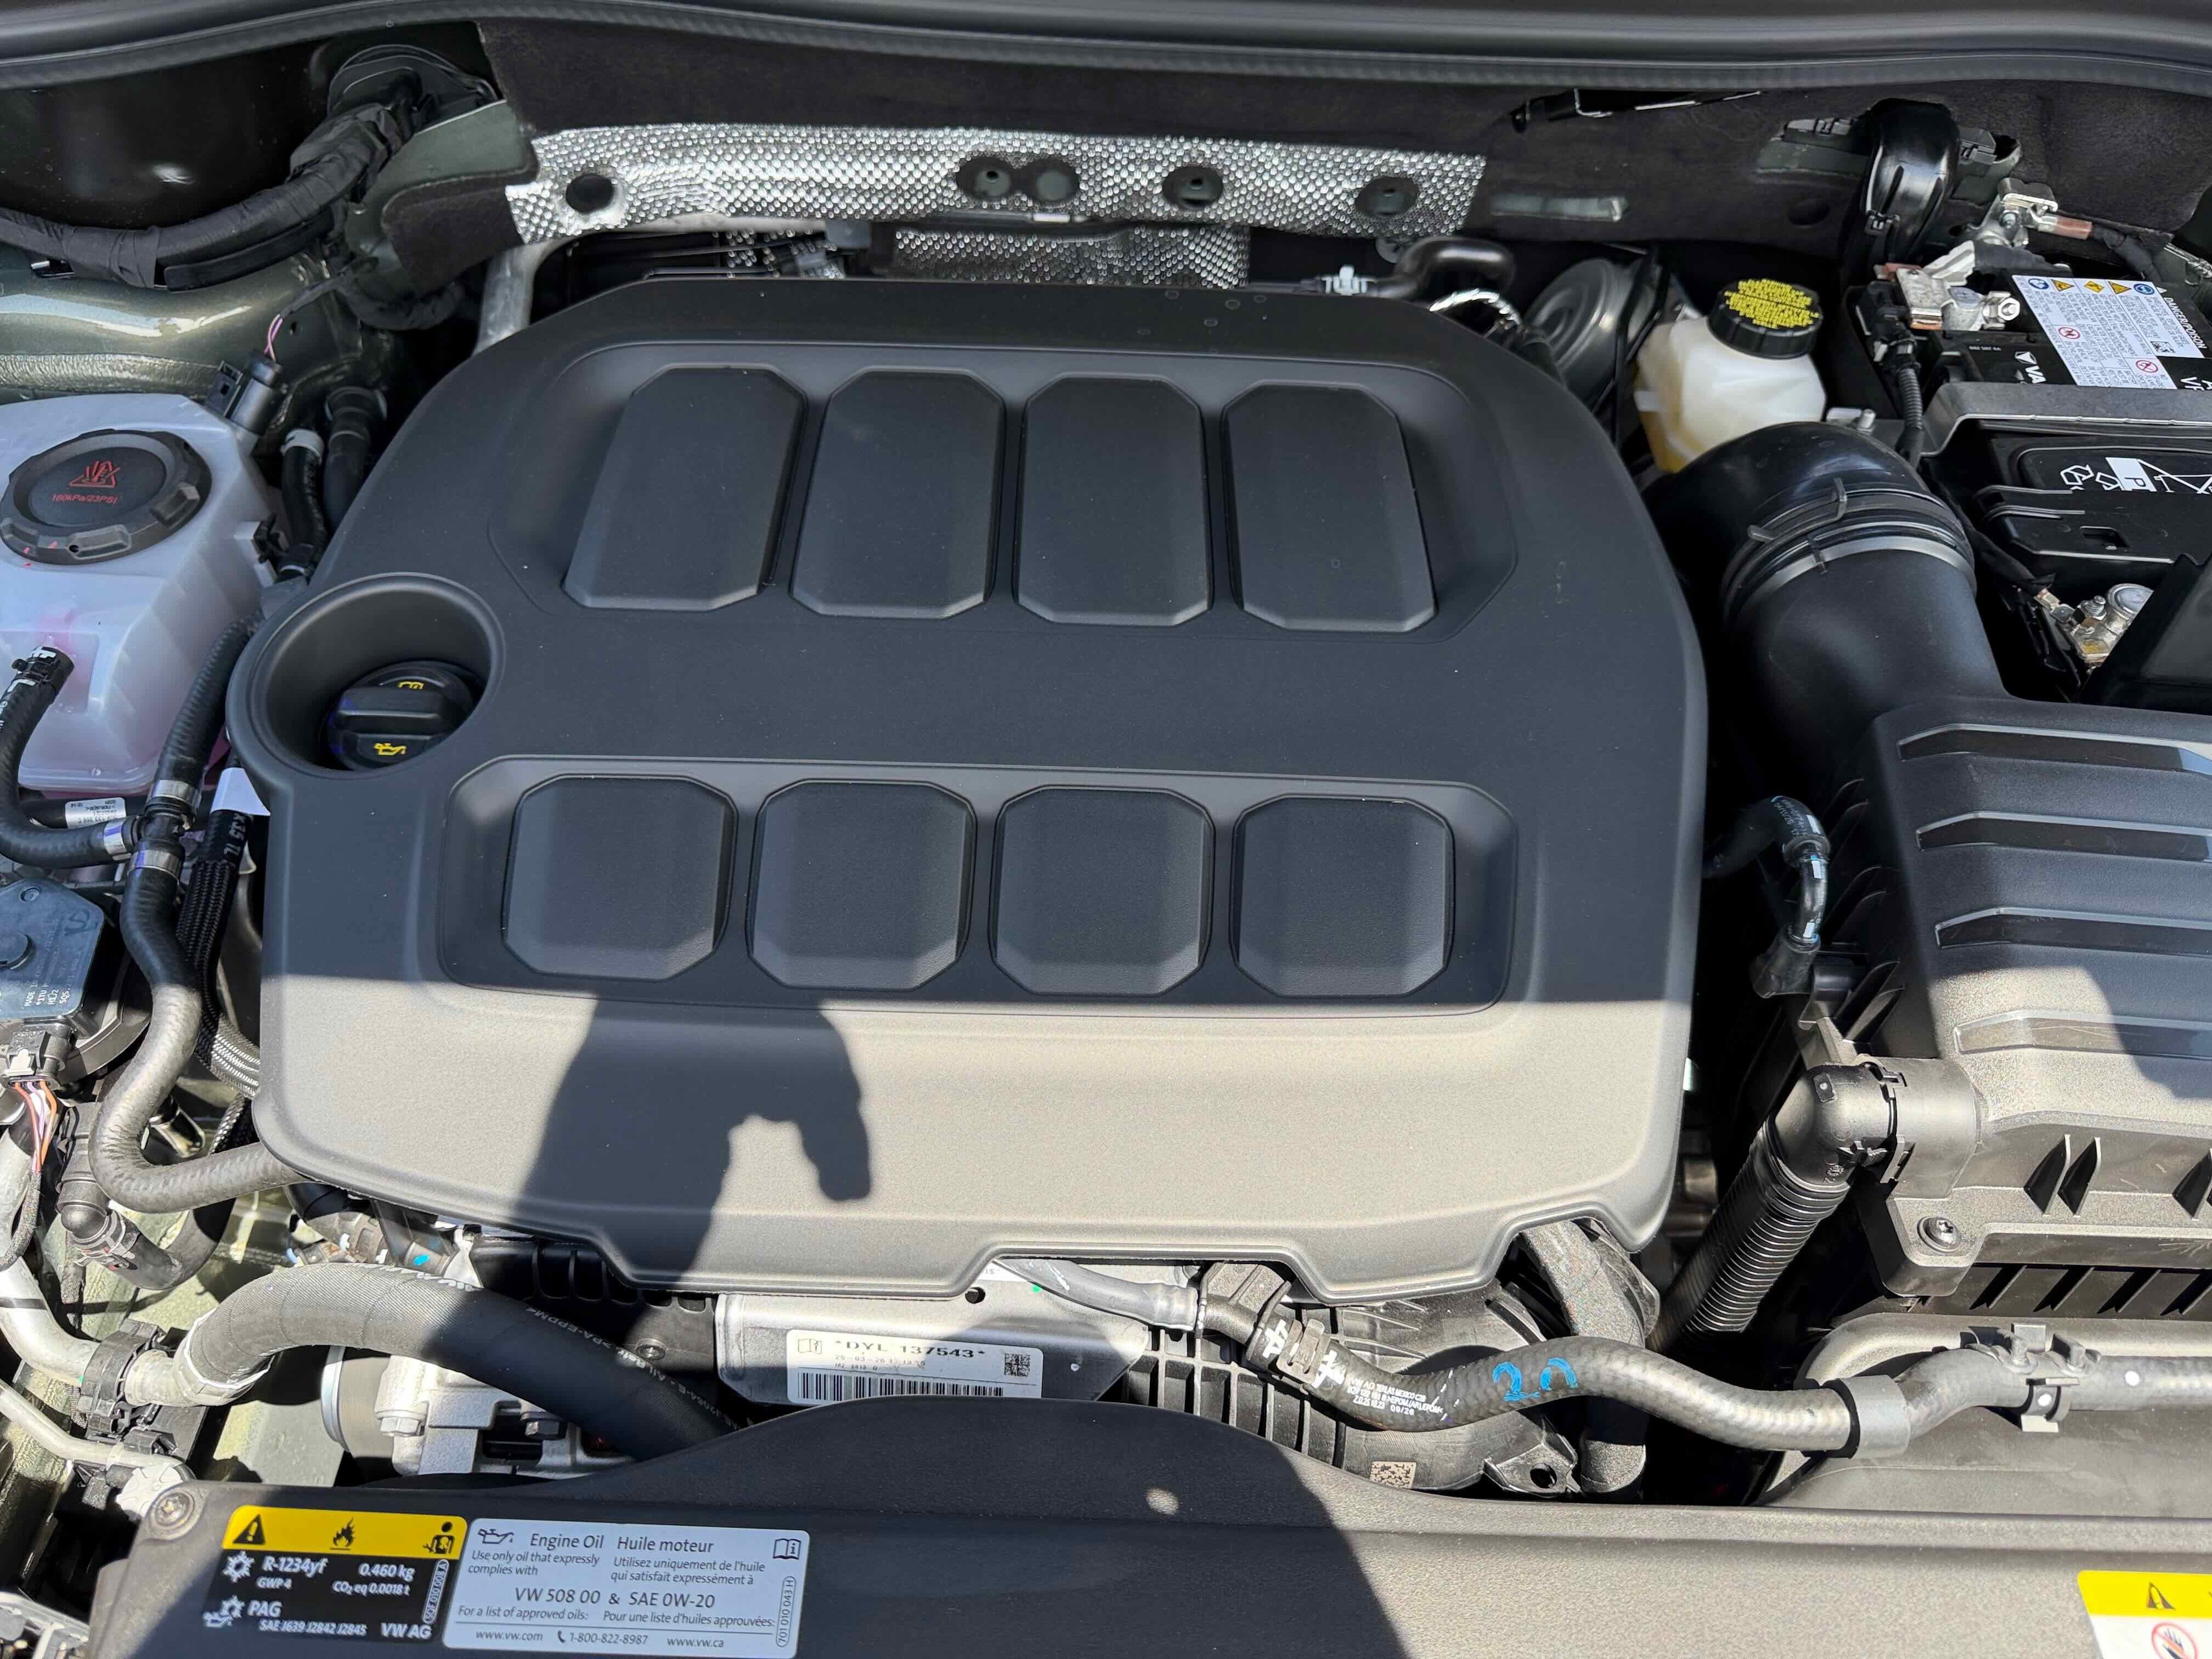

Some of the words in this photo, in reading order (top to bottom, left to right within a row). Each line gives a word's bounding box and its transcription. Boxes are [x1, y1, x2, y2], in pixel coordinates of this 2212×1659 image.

[530, 1533, 579, 1551] Engine
[583, 1534, 604, 1549] Oil
[617, 1536, 656, 1551] Huile
[659, 1538, 714, 1553] moteur
[472, 1550, 490, 1561] Use
[492, 1551, 515, 1564] only
[515, 1551, 528, 1561] oil
[531, 1552, 551, 1563] that
[553, 1554, 601, 1567] expressly
[614, 1556, 652, 1569] Utilisez
[653, 1558, 716, 1573] uniquement
[719, 1559, 732, 1571] de
[734, 1561, 766, 1572] l'huile
[262, 1555, 329, 1578] R-1234yf
[358, 1563, 397, 1577] 0.460
[398, 1565, 415, 1582] kg
[468, 1565, 512, 1577] complies
[515, 1565, 538, 1576] with
[256, 1576, 283, 1589] GWP
[354, 1584, 368, 1597] eq
[368, 1582, 403, 1595] 0.0018
[611, 1571, 628, 1583] qui
[629, 1571, 671, 1583] satisfait
[673, 1573, 746, 1586] expressément
[747, 1575, 754, 1585] à
[785, 1579, 795, 1588] H
[515, 1587, 543, 1602] VW
[545, 1589, 576, 1604] 508
[579, 1590, 601, 1604] 00
[608, 1593, 620, 1605] &
[628, 1592, 659, 1606] SAE
[662, 1593, 716, 1609] 0W-20
[247, 1600, 283, 1618] PAG
[458, 1605, 475, 1616] For
[476, 1608, 483, 1616] a
[486, 1606, 501, 1617] list
[503, 1606, 516, 1618] of
[516, 1608, 566, 1622] approved
[567, 1610, 589, 1621] oils:
[603, 1610, 627, 1623] Pour
[629, 1613, 649, 1623] une
[650, 1611, 672, 1624] liste
[673, 1612, 712, 1625] d'huiles
[713, 1615, 776, 1629] approuvées:
[258, 1618, 281, 1632] SAE
[380, 1622, 408, 1638] VW
[407, 1624, 432, 1640] AG
[476, 1632, 544, 1641] www.vw.com
[569, 1632, 649, 1645] 1-800-822-8987
[667, 1636, 725, 1648] www.vw.ca
